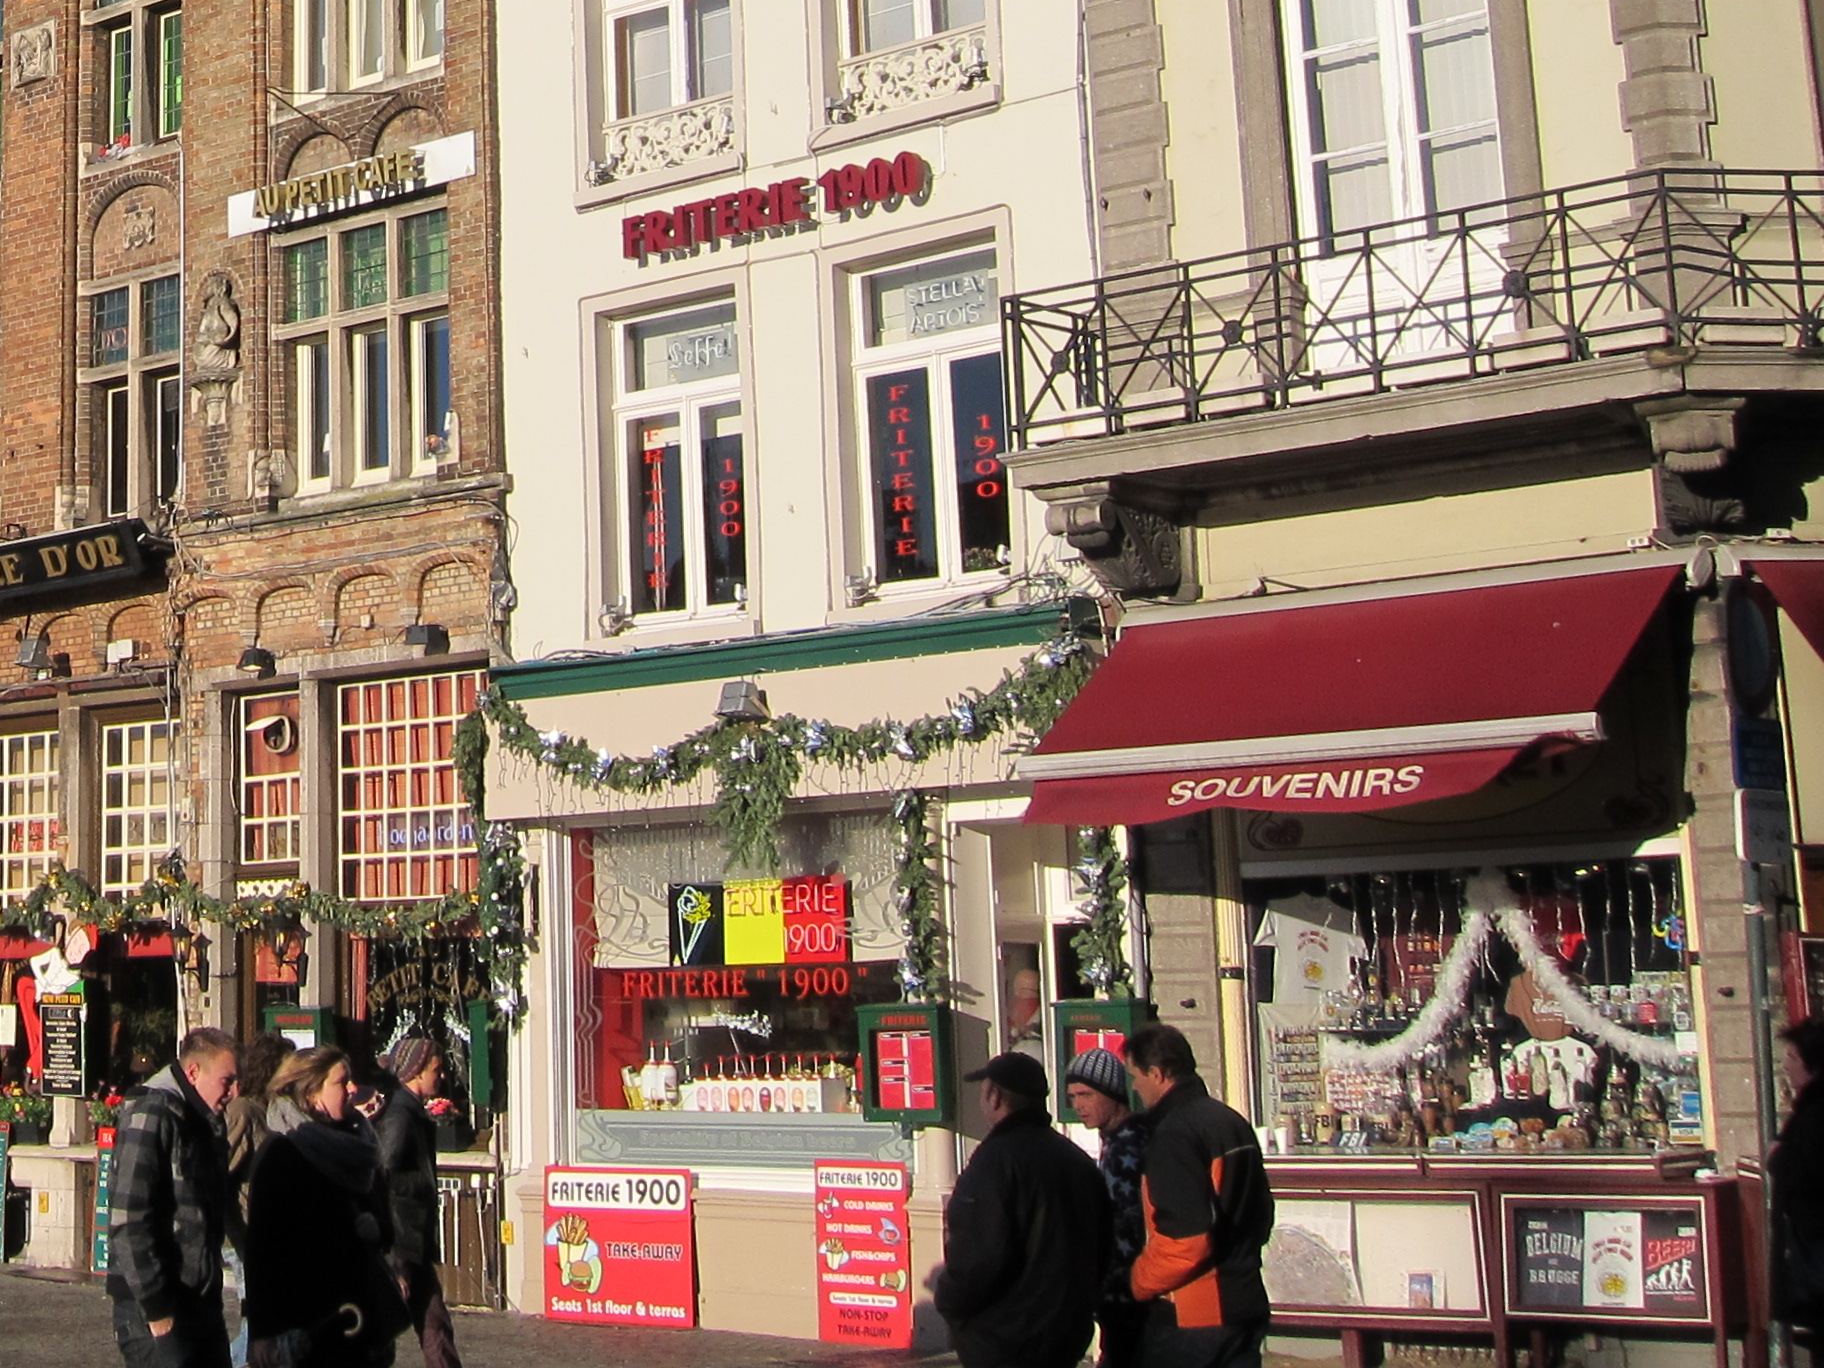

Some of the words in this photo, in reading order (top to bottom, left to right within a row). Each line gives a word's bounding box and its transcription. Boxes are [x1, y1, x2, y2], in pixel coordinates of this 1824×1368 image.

[253, 186, 279, 218] AU
[286, 167, 350, 210] PETIT
[623, 177, 810, 259] FRITERIE
[817, 151, 923, 212] 1900
[906, 275, 984, 308] STELLA
[910, 303, 980, 335] ARTOIS
[973, 414, 1002, 498] 1900
[887, 384, 919, 558] FRITERIE
[642, 427, 670, 589] FRITERIE
[719, 458, 742, 537] 1900
[39, 534, 124, 578] D'OR
[1167, 764, 1425, 807] SOUVENIRS
[724, 884, 837, 917] FRITERIE
[784, 923, 836, 952] 1900
[623, 970, 750, 998] FRITERIE
[1339, 1132, 1368, 1146] FBI
[551, 1182, 621, 1203] FRITERIE
[626, 1179, 681, 1205] 1900
[819, 1172, 863, 1186] FRITERIE
[865, 1171, 898, 1187] 1900
[844, 1200, 864, 1210] COLD
[865, 1201, 894, 1212] DRINKS
[826, 1223, 842, 1233] HOT
[844, 1224, 873, 1234] DRINKS
[606, 1241, 683, 1261] TAKE-AWAY
[1525, 1232, 1583, 1261] BELGIUM
[822, 1273, 875, 1285] HAMBURGERS
[1529, 1268, 1580, 1285] BRUGGE
[551, 1296, 582, 1313] Seats
[586, 1298, 603, 1314] 1st
[605, 1300, 632, 1315] floor
[635, 1301, 647, 1316] &
[649, 1303, 686, 1318] terras
[839, 1308, 889, 1321] NON-STOP
[838, 1324, 891, 1338] TAKE-AWAY
